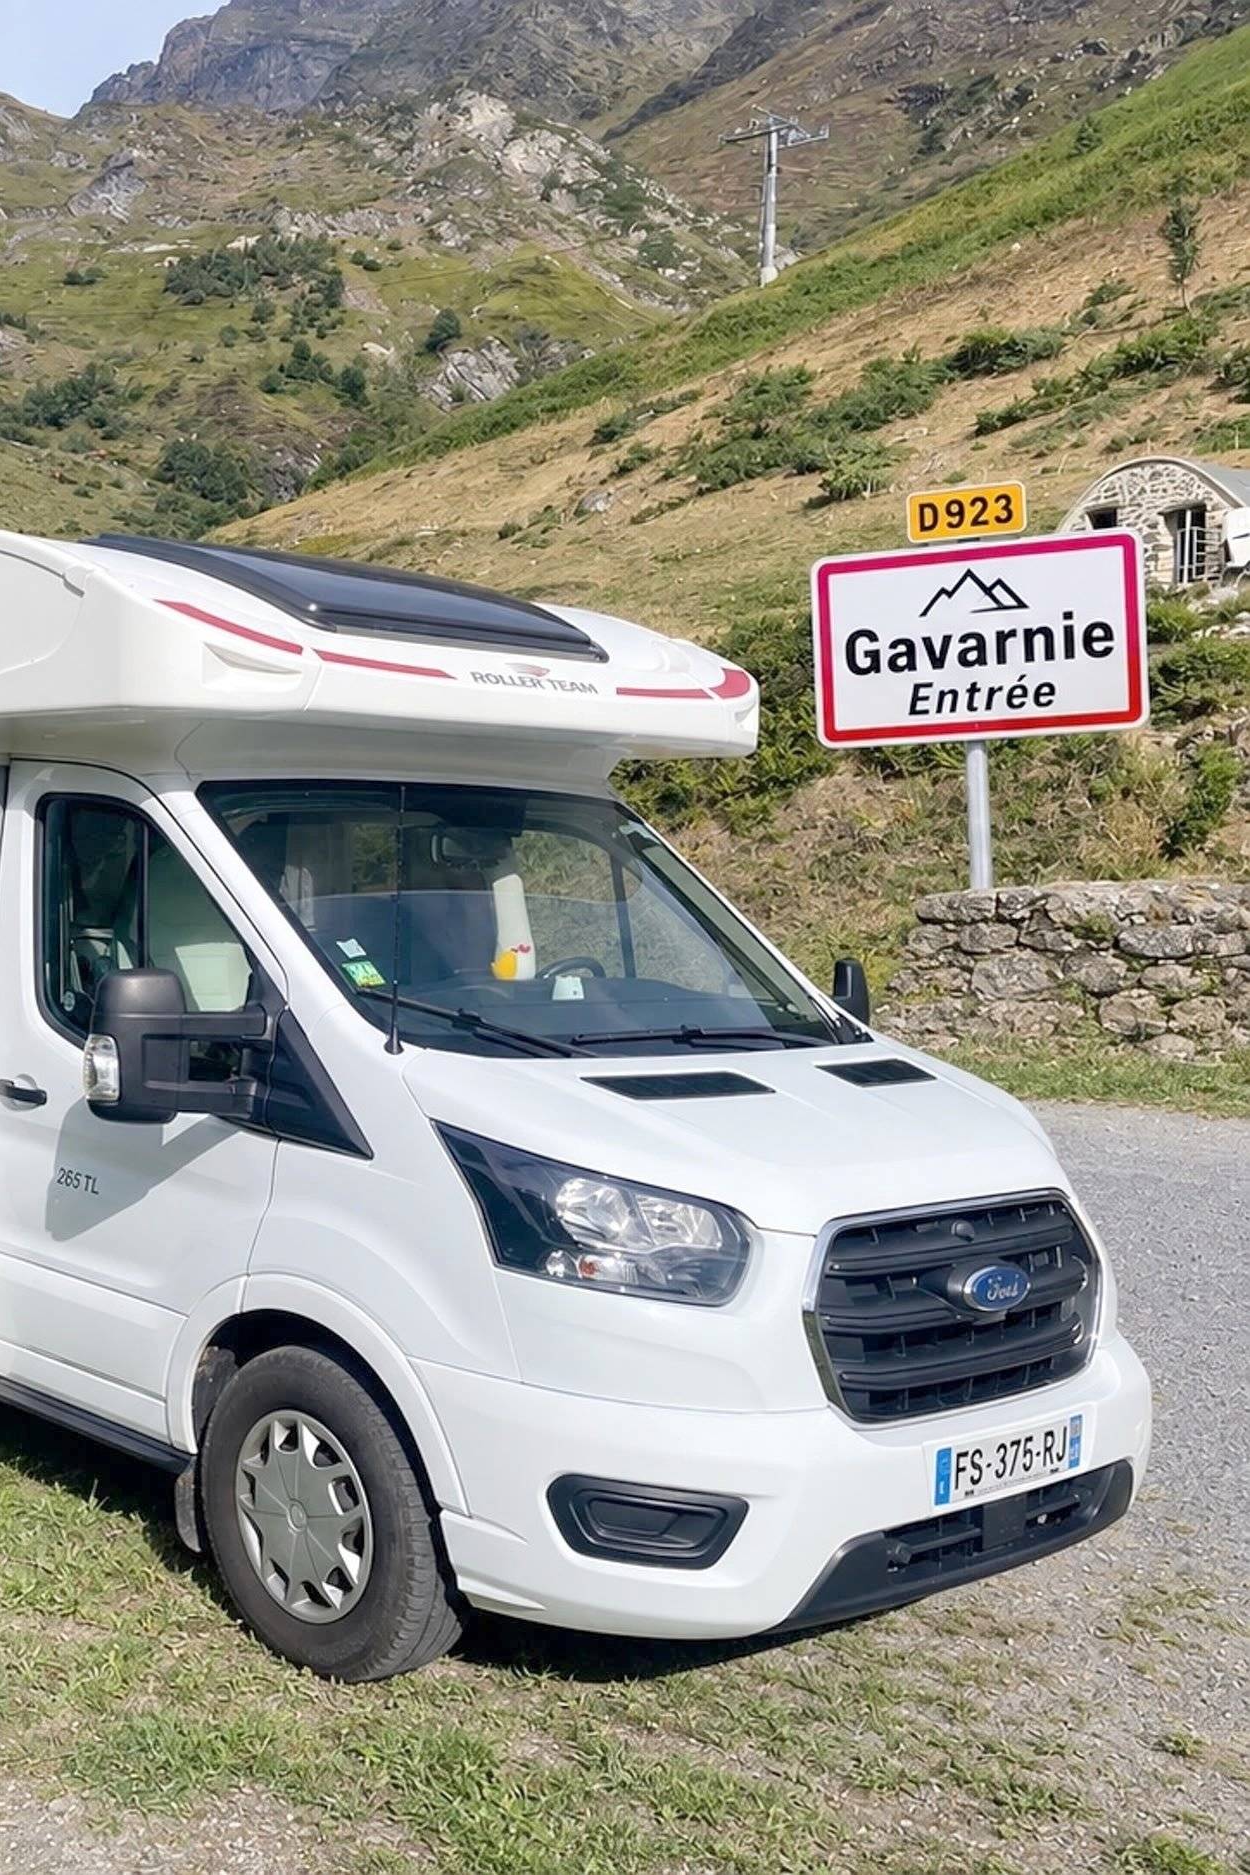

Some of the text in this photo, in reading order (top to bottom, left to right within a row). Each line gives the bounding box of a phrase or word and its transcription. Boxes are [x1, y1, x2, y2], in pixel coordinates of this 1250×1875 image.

[918, 493, 1015, 533] D923
[845, 611, 1115, 676] Gavarnie
[470, 671, 599, 695] ROLLER TEAM
[908, 674, 1057, 716] Entrée
[57, 1167, 99, 1195] 265 TL
[954, 1426, 1068, 1491] FS-375-RJ
